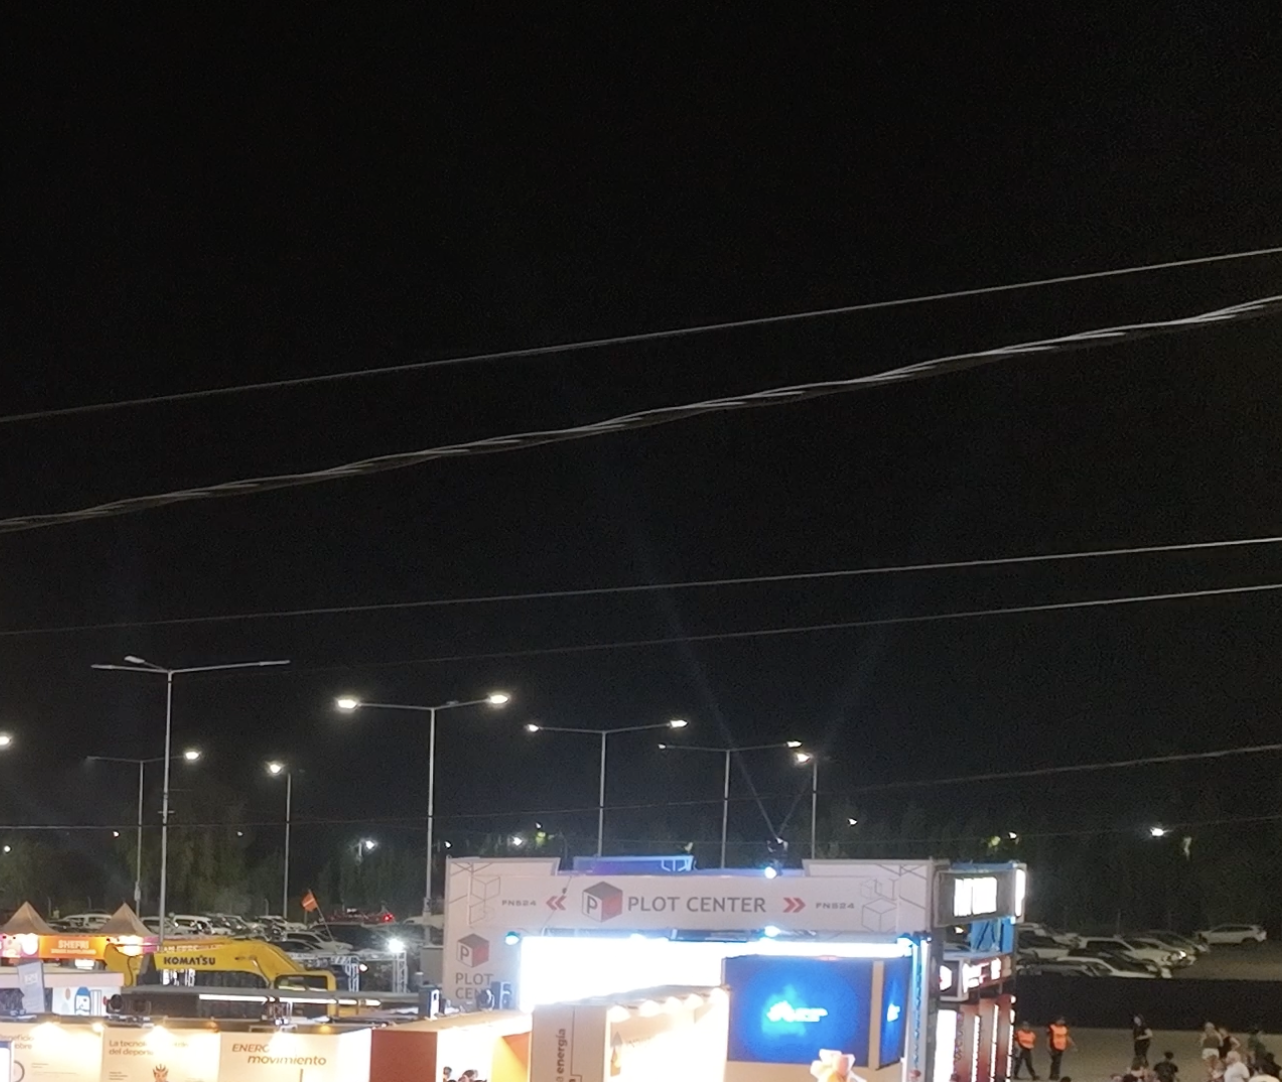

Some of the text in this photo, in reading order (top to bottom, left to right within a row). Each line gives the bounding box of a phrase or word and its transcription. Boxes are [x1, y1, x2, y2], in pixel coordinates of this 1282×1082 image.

[627, 896, 767, 914] PLOT CENTER
[163, 955, 216, 966] KOMATSU
[455, 972, 494, 985] PLOT
[555, 1028, 568, 1074] energía
[247, 1054, 327, 1066] movimiento
